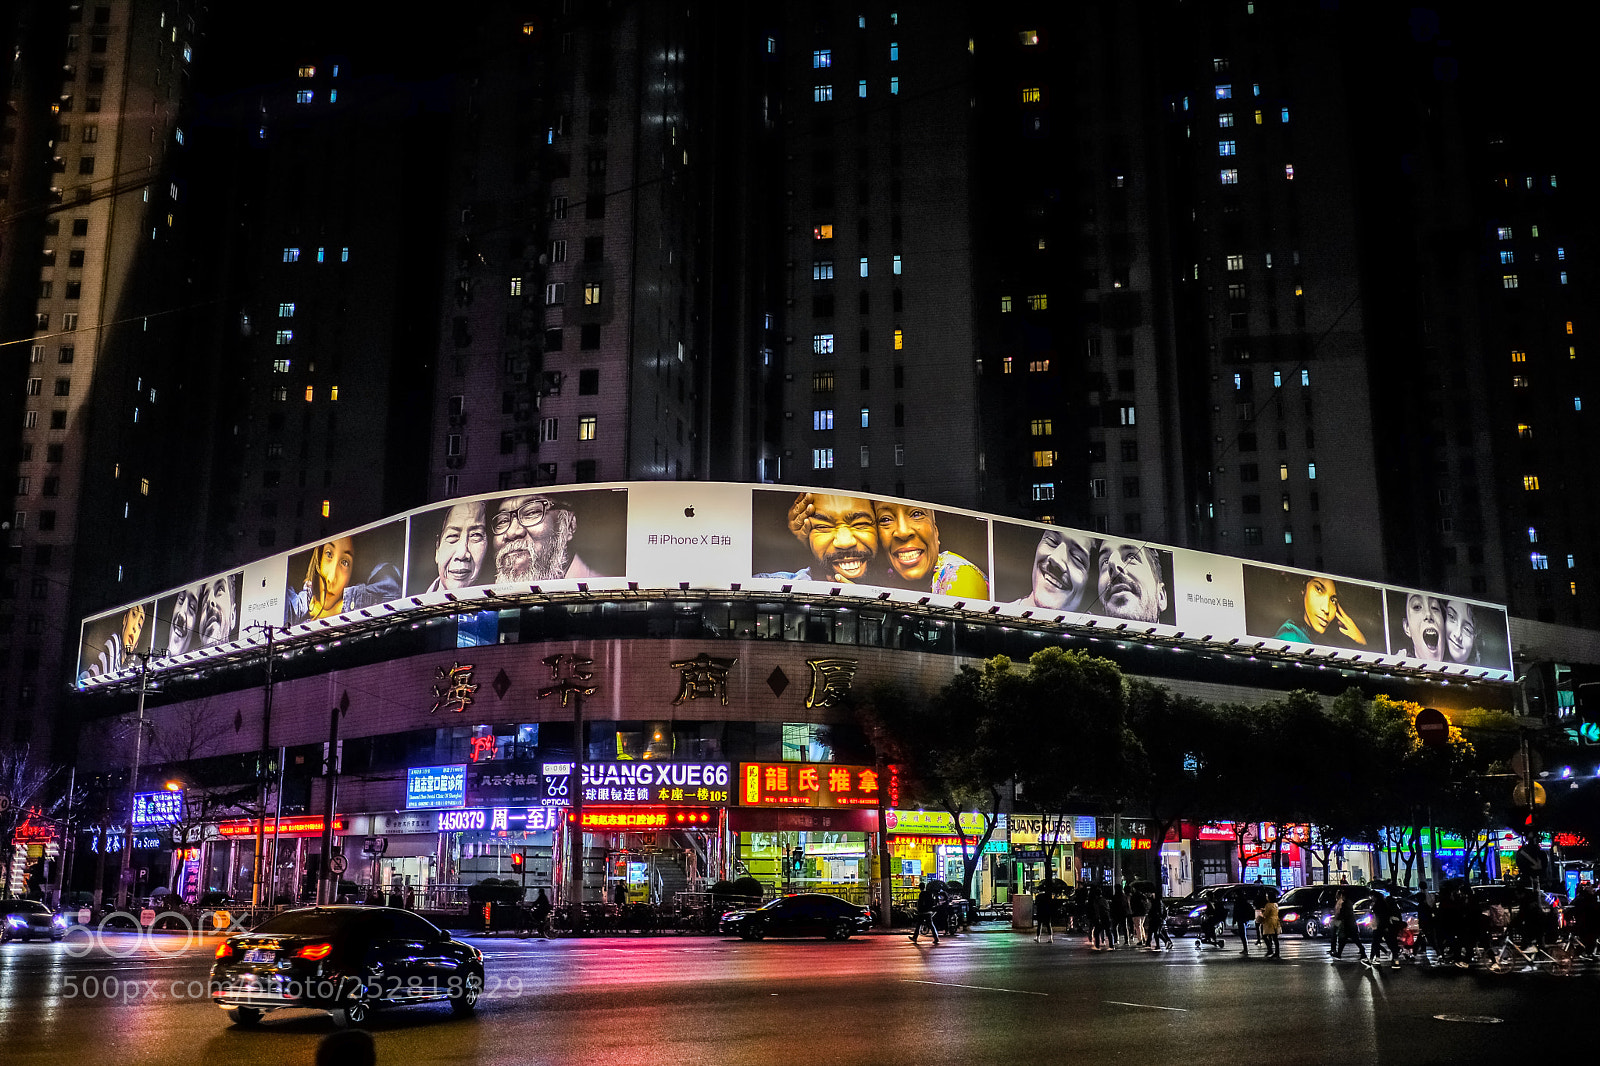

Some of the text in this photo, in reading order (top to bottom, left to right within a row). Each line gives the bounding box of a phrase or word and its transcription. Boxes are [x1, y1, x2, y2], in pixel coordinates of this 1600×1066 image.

[648, 535, 731, 545] 用 iPhone X 自拍
[1194, 594, 1215, 605] iPhone
[764, 766, 879, 793] 龍氏推拿
[582, 787, 649, 801] 球眼镜连锁
[658, 787, 728, 801] 本座一楼105
[541, 798, 570, 806] OPTICAL
[582, 814, 667, 826] 上海赵志堂口腔诊所
[143, 837, 160, 848] Scene
